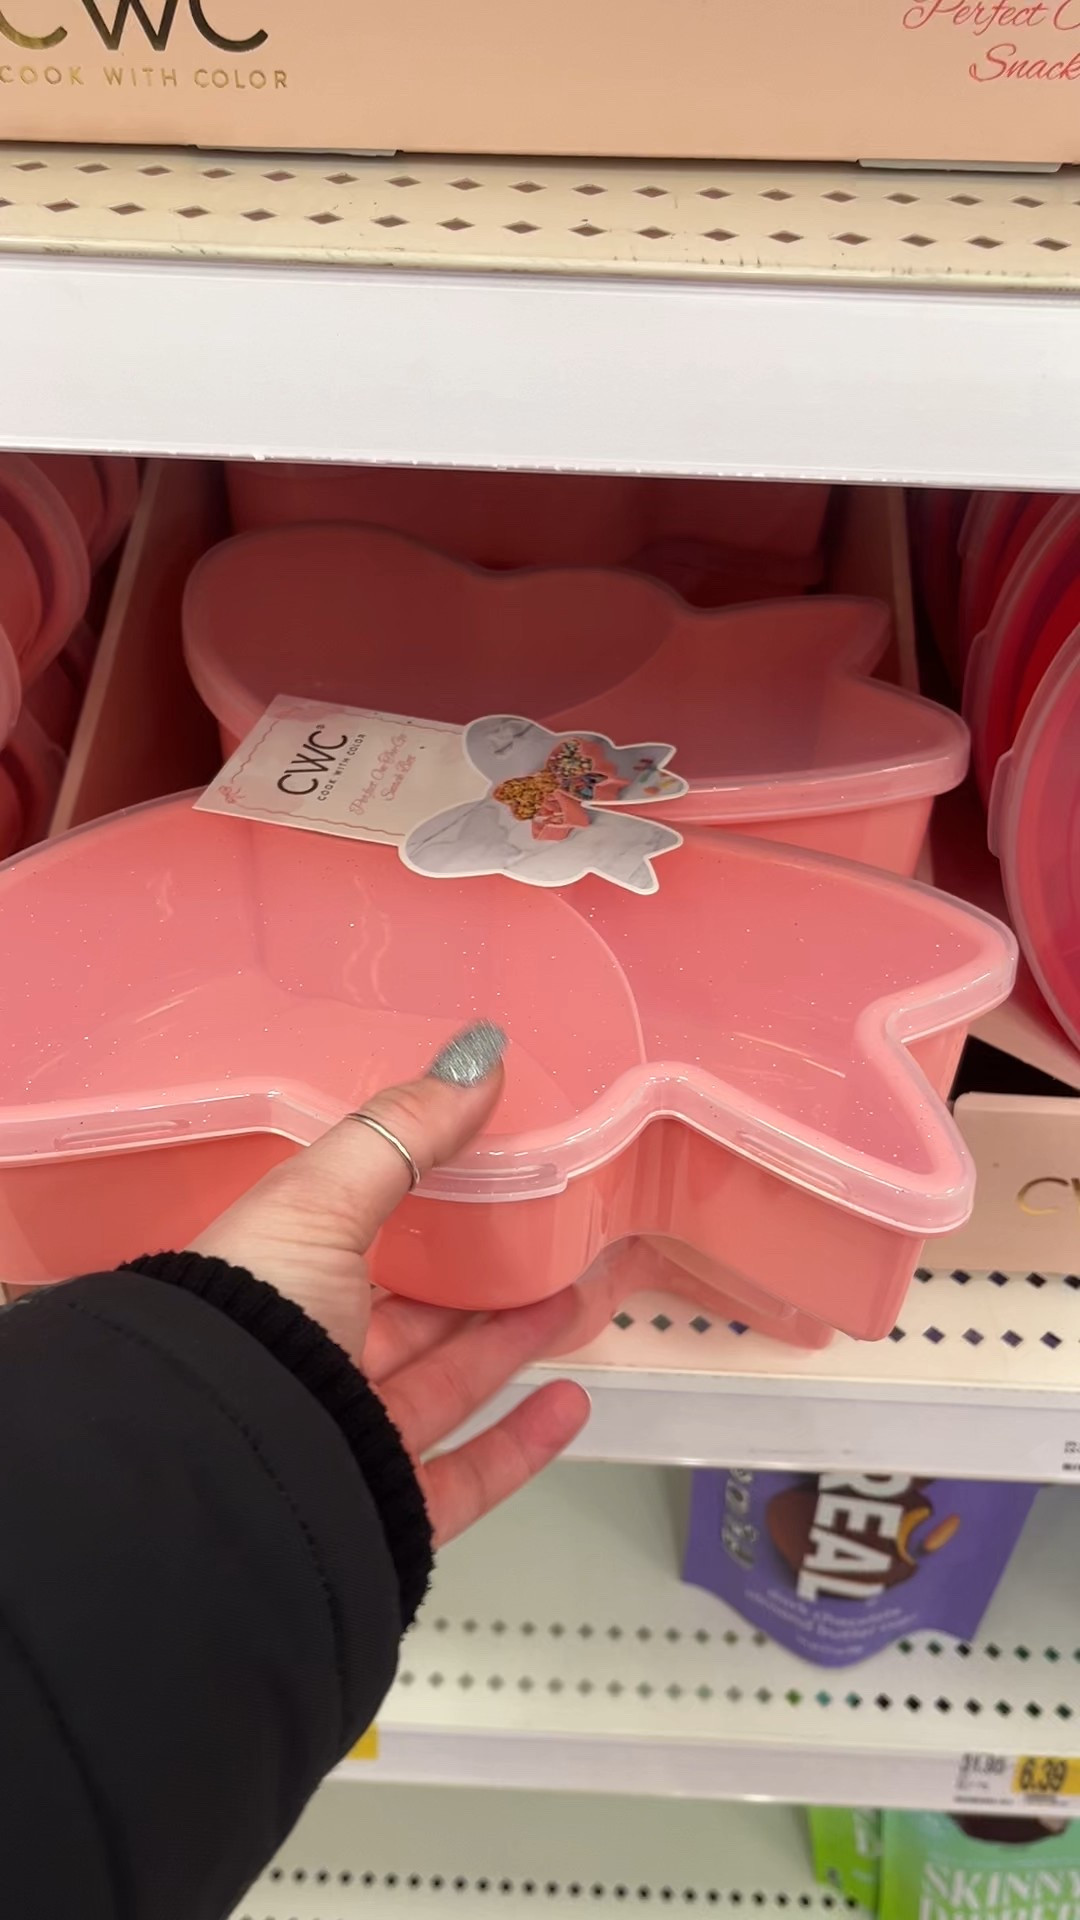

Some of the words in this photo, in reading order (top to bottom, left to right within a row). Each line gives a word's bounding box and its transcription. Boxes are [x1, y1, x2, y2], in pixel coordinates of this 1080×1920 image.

[0, 65, 84, 86] COOK
[103, 67, 177, 87] WITH
[194, 69, 288, 89] COLOR
[969, 43, 1080, 82] Snack
[317, 780, 338, 802] COOK
[335, 757, 351, 776] WITH
[347, 733, 367, 756] COLOR
